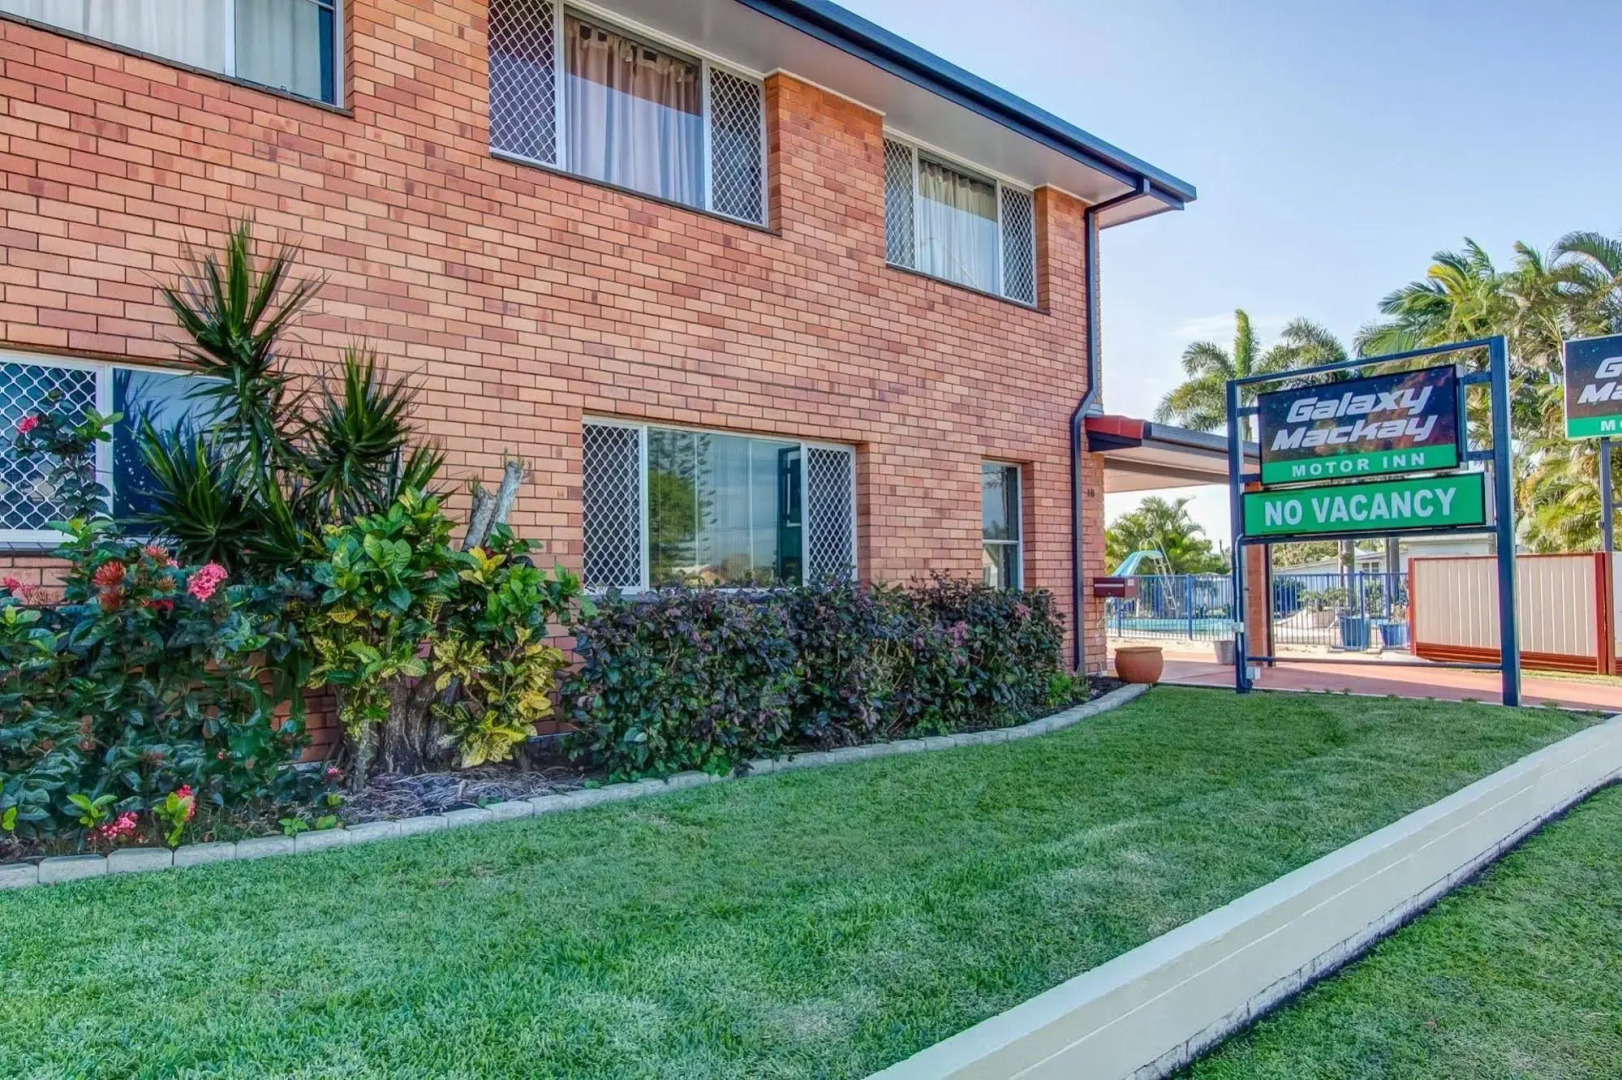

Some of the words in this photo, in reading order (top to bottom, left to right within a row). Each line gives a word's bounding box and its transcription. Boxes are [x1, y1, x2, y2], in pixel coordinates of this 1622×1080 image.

[1286, 386, 1433, 424] Galaxy
[1271, 414, 1438, 451] Mackay
[1292, 458, 1370, 477] MOTOR
[1382, 452, 1426, 468] INN
[1264, 499, 1303, 527] NO
[1311, 487, 1457, 524] VACANCY
